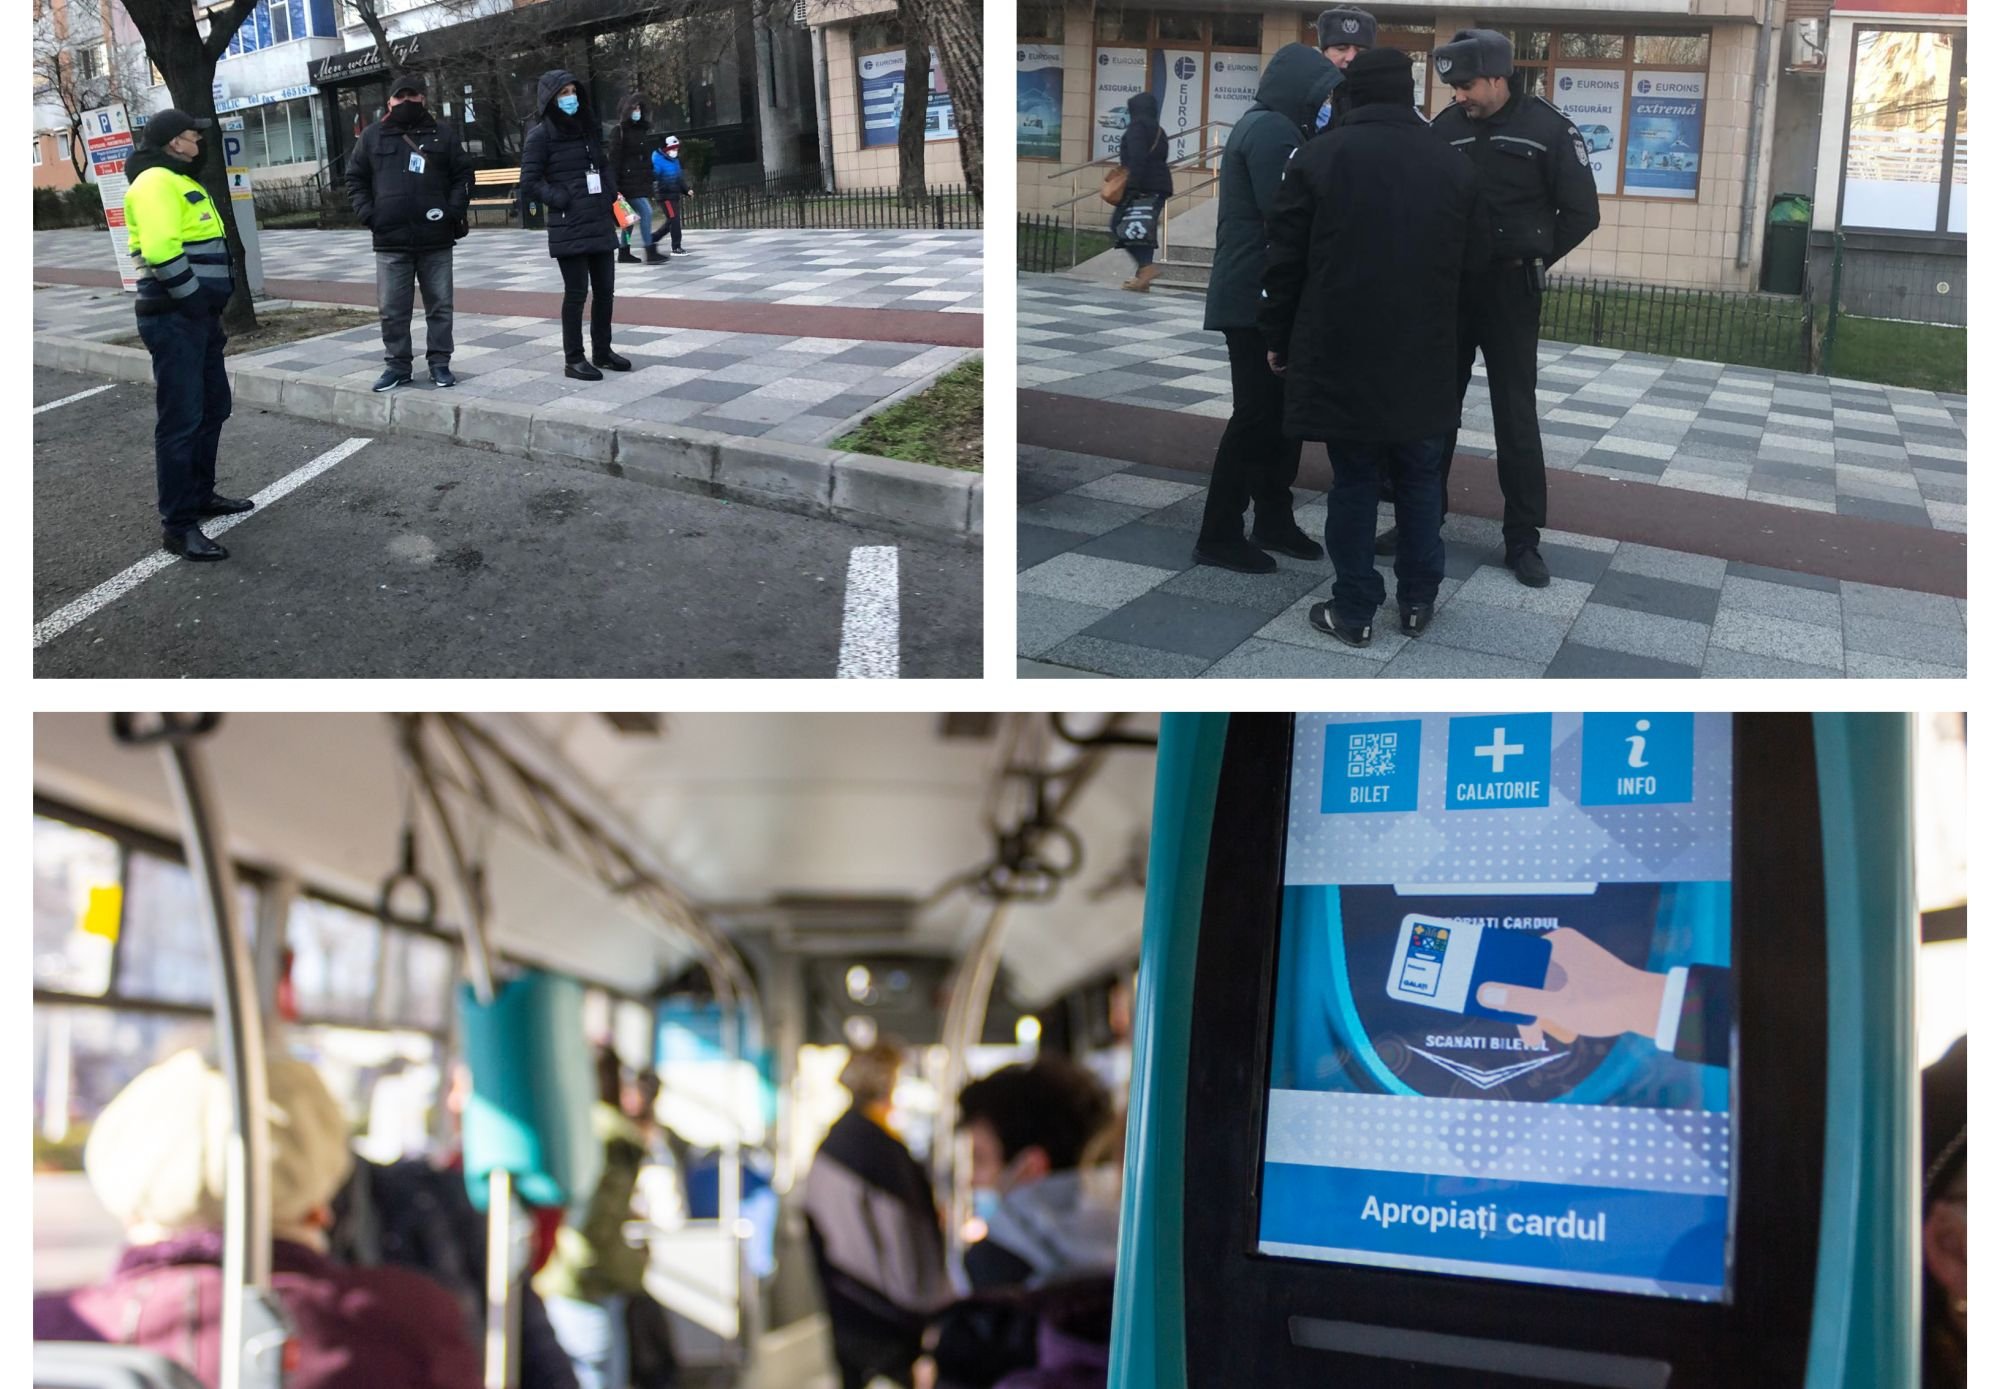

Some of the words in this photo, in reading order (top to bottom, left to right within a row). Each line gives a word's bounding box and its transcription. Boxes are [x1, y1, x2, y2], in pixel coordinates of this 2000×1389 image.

[1227, 64, 1258, 72] EUROINS
[1577, 80, 1619, 90] EUROINS
[1656, 83, 1699, 93] EUROINS
[248, 95, 259, 104] tel
[1637, 103, 1697, 115] extremă
[101, 116, 108, 131] P
[224, 138, 240, 166] P
[1350, 785, 1390, 803] BILET
[1457, 781, 1540, 801] CALATORIE
[1617, 777, 1656, 796] INFO
[1503, 916, 1559, 929] CARDUL
[1425, 1035, 1486, 1049] SCANATI
[1490, 1036, 1550, 1052] BILEL
[1361, 1195, 1496, 1239] Apropiați
[1506, 1210, 1606, 1242] cardul
